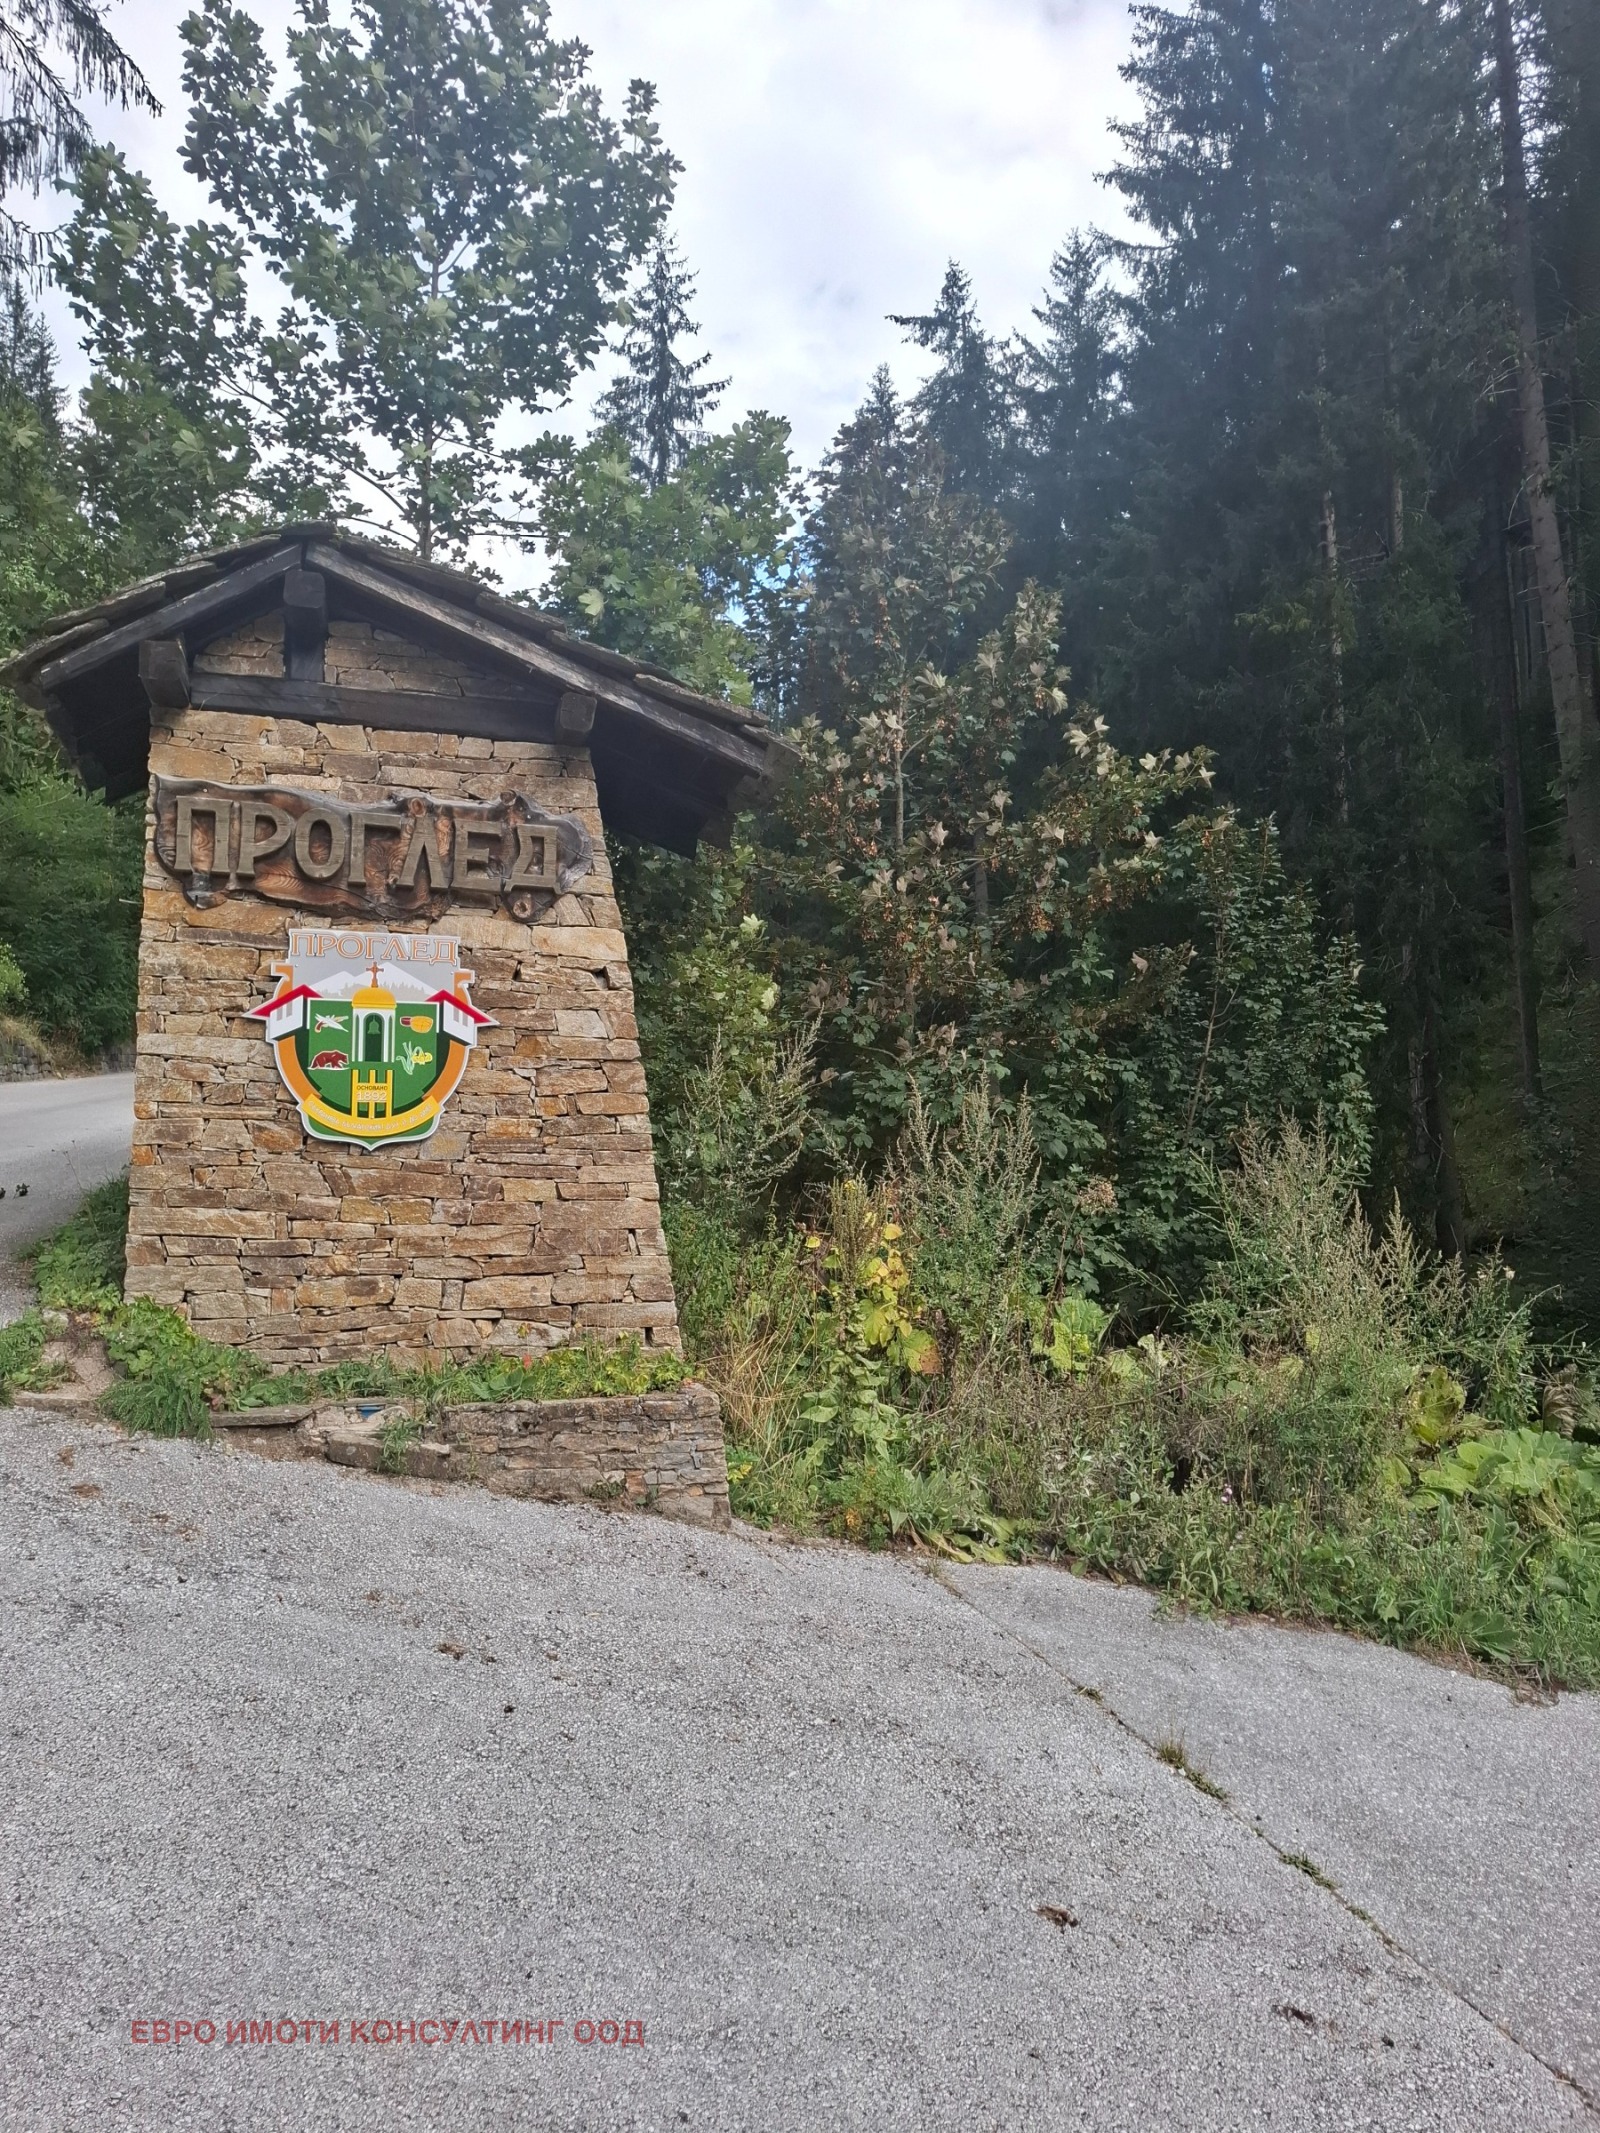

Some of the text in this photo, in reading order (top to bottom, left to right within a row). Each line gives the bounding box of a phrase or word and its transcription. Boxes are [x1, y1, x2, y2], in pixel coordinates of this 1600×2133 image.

[174, 796, 561, 895] ПРОГЛЕД
[291, 932, 458, 965] ПРОГЛЕД
[356, 1091, 387, 1100] 1892
